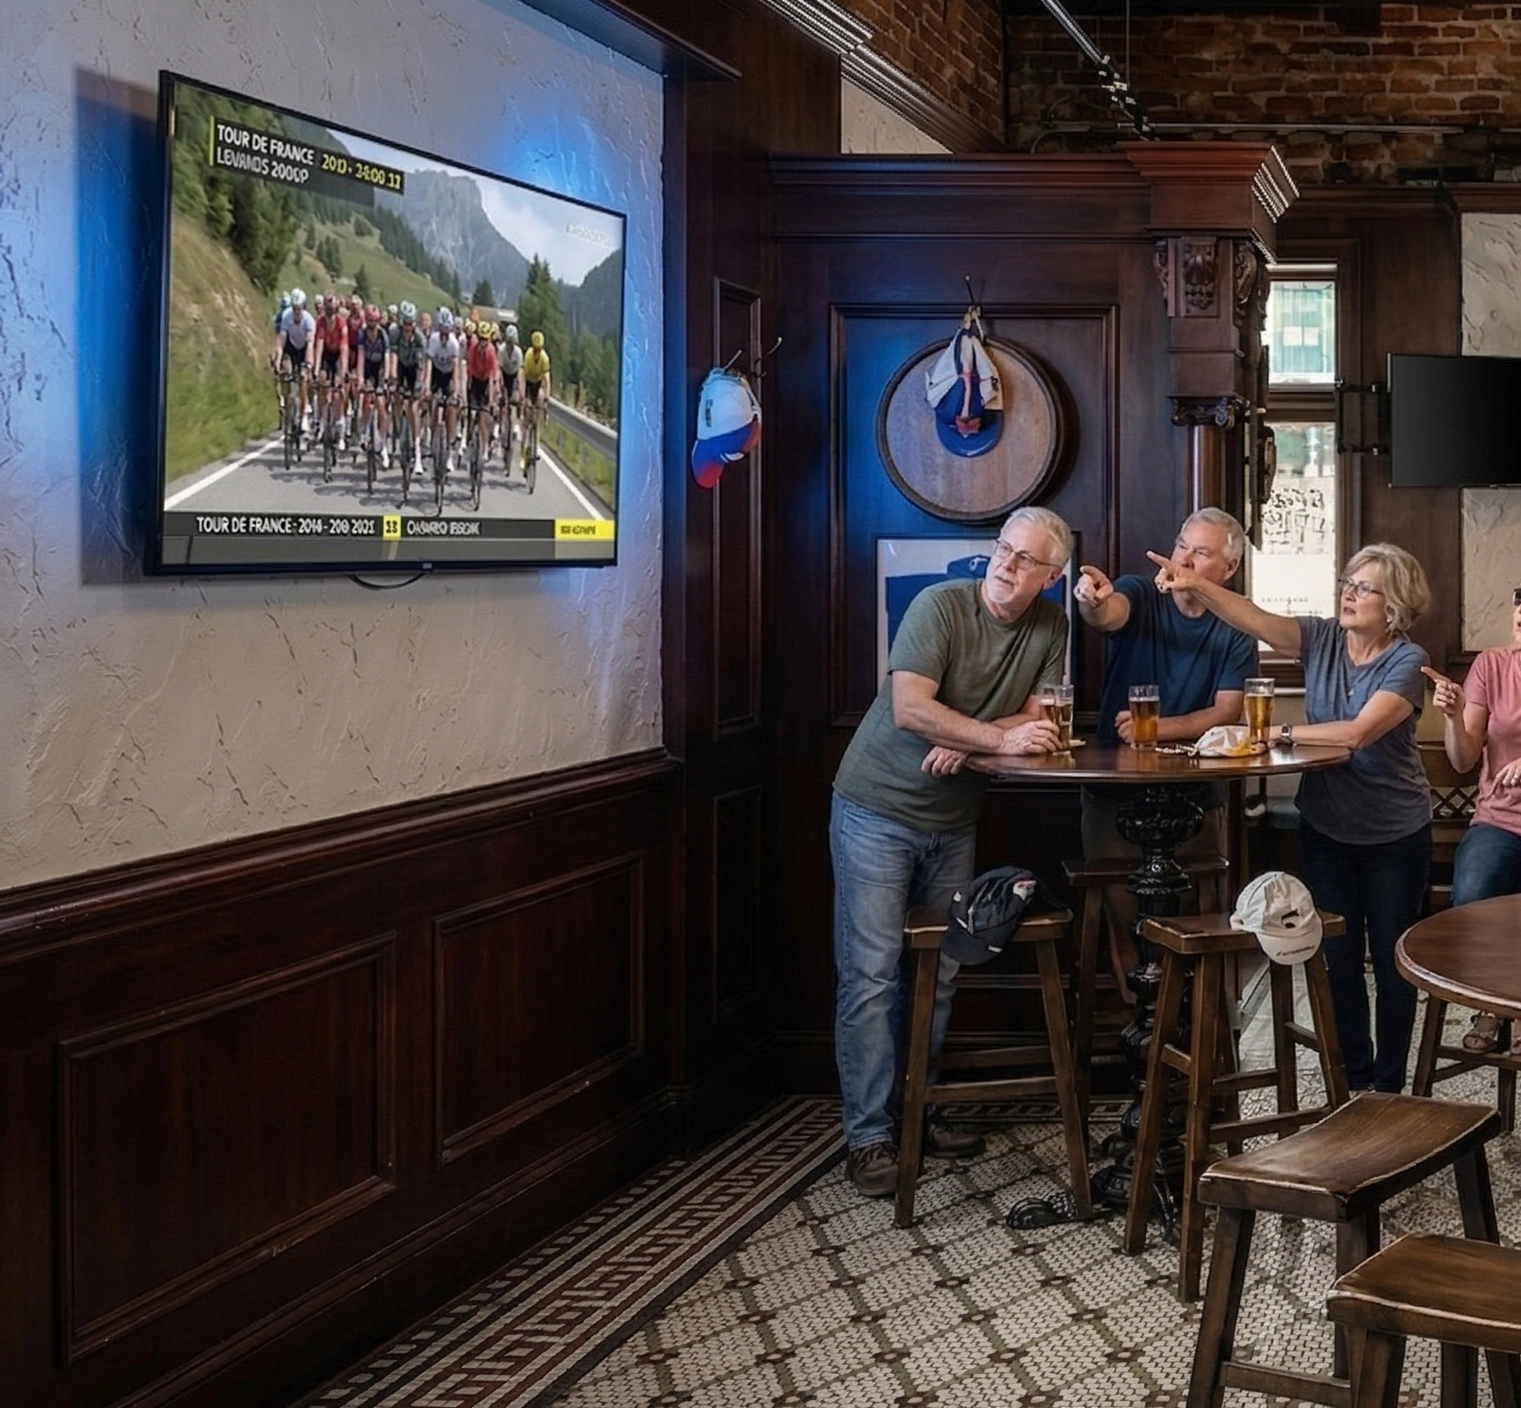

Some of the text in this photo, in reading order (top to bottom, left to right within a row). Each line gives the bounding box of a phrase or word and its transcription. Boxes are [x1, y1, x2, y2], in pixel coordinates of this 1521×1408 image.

[217, 124, 250, 148] TOUR
[252, 134, 268, 153] DE
[270, 139, 315, 165] FRANCE
[196, 516, 230, 533] TOUR
[232, 516, 247, 533] DE
